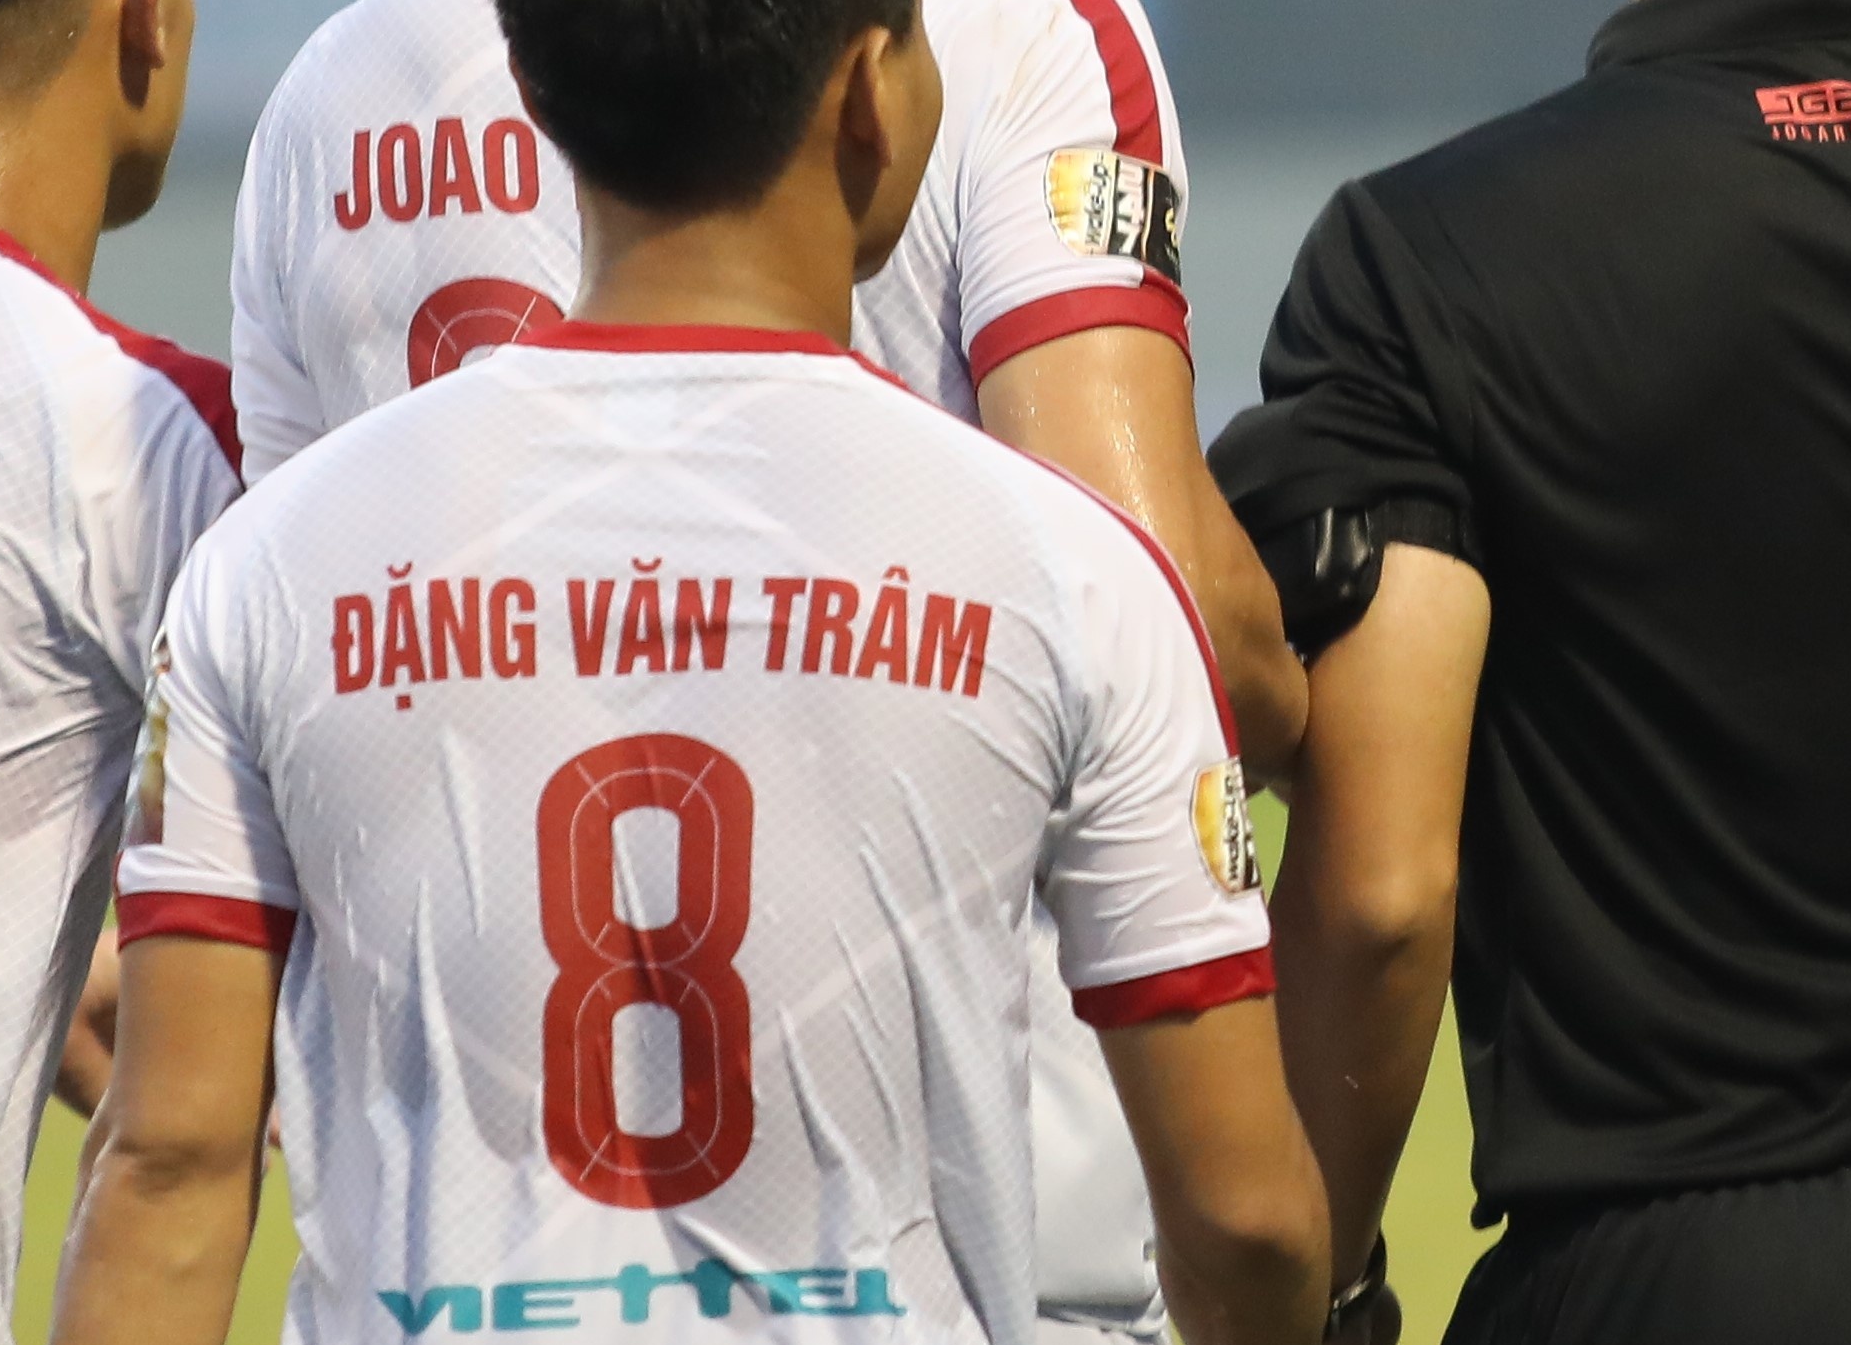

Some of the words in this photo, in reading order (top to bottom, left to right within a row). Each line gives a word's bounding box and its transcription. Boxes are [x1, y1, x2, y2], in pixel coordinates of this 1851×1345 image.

[334, 117, 540, 231] JOAO
[331, 561, 537, 710] ĐẶNG
[568, 558, 733, 677] VĂN
[763, 566, 993, 698] TRÂM
[536, 731, 755, 1210] 8
